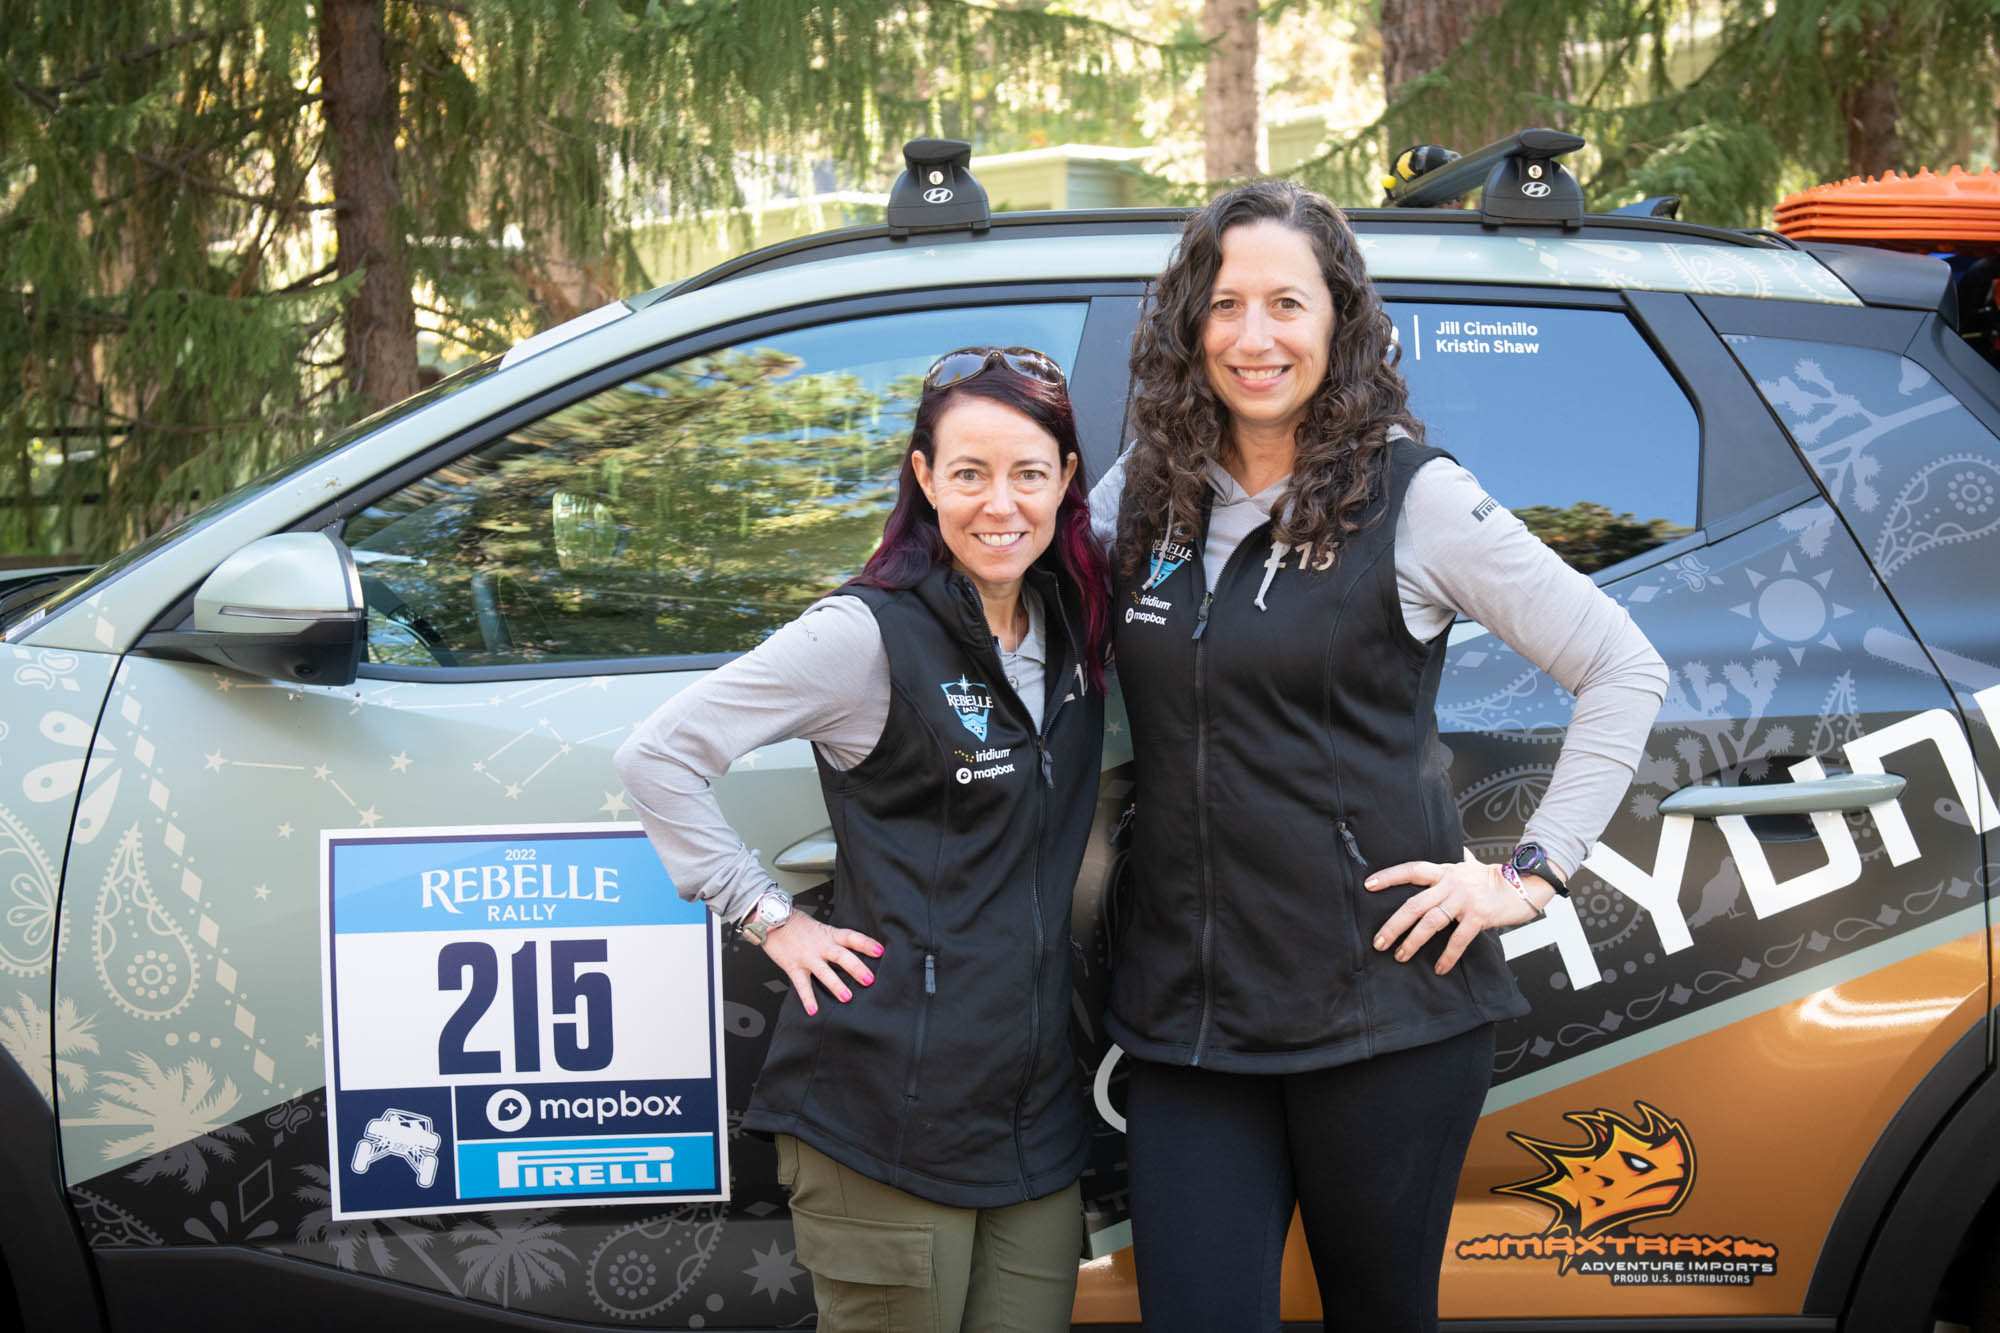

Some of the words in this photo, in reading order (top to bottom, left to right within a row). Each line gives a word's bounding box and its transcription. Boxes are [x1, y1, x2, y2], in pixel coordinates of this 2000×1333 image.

[1436, 321, 1460, 335] Jill
[1464, 322, 1538, 336] Ciminillo
[1436, 339, 1490, 353] Kristin
[1494, 340, 1540, 354] Shaw
[1140, 594, 1172, 611] iridium
[1133, 611, 1167, 626] mapbox
[945, 694, 994, 710] REBELLE
[975, 748, 1011, 763] iridium
[973, 763, 1015, 780] mapbox
[504, 848, 537, 861] 2022
[421, 864, 621, 915] REBELLE
[487, 904, 557, 922] RALLY
[437, 938, 614, 1076] 215
[539, 1090, 682, 1125] mapbox
[498, 1145, 675, 1189] PIRELLI
[1500, 1235, 1733, 1257] MAXTRAX
[1580, 1261, 1684, 1272] ADVENTURE
[1688, 1261, 1774, 1273] IMPORTS
[1613, 1273, 1649, 1284] PROUD
[1651, 1273, 1672, 1284] U.S.
[1675, 1274, 1751, 1284] DISTRIBUTORS
